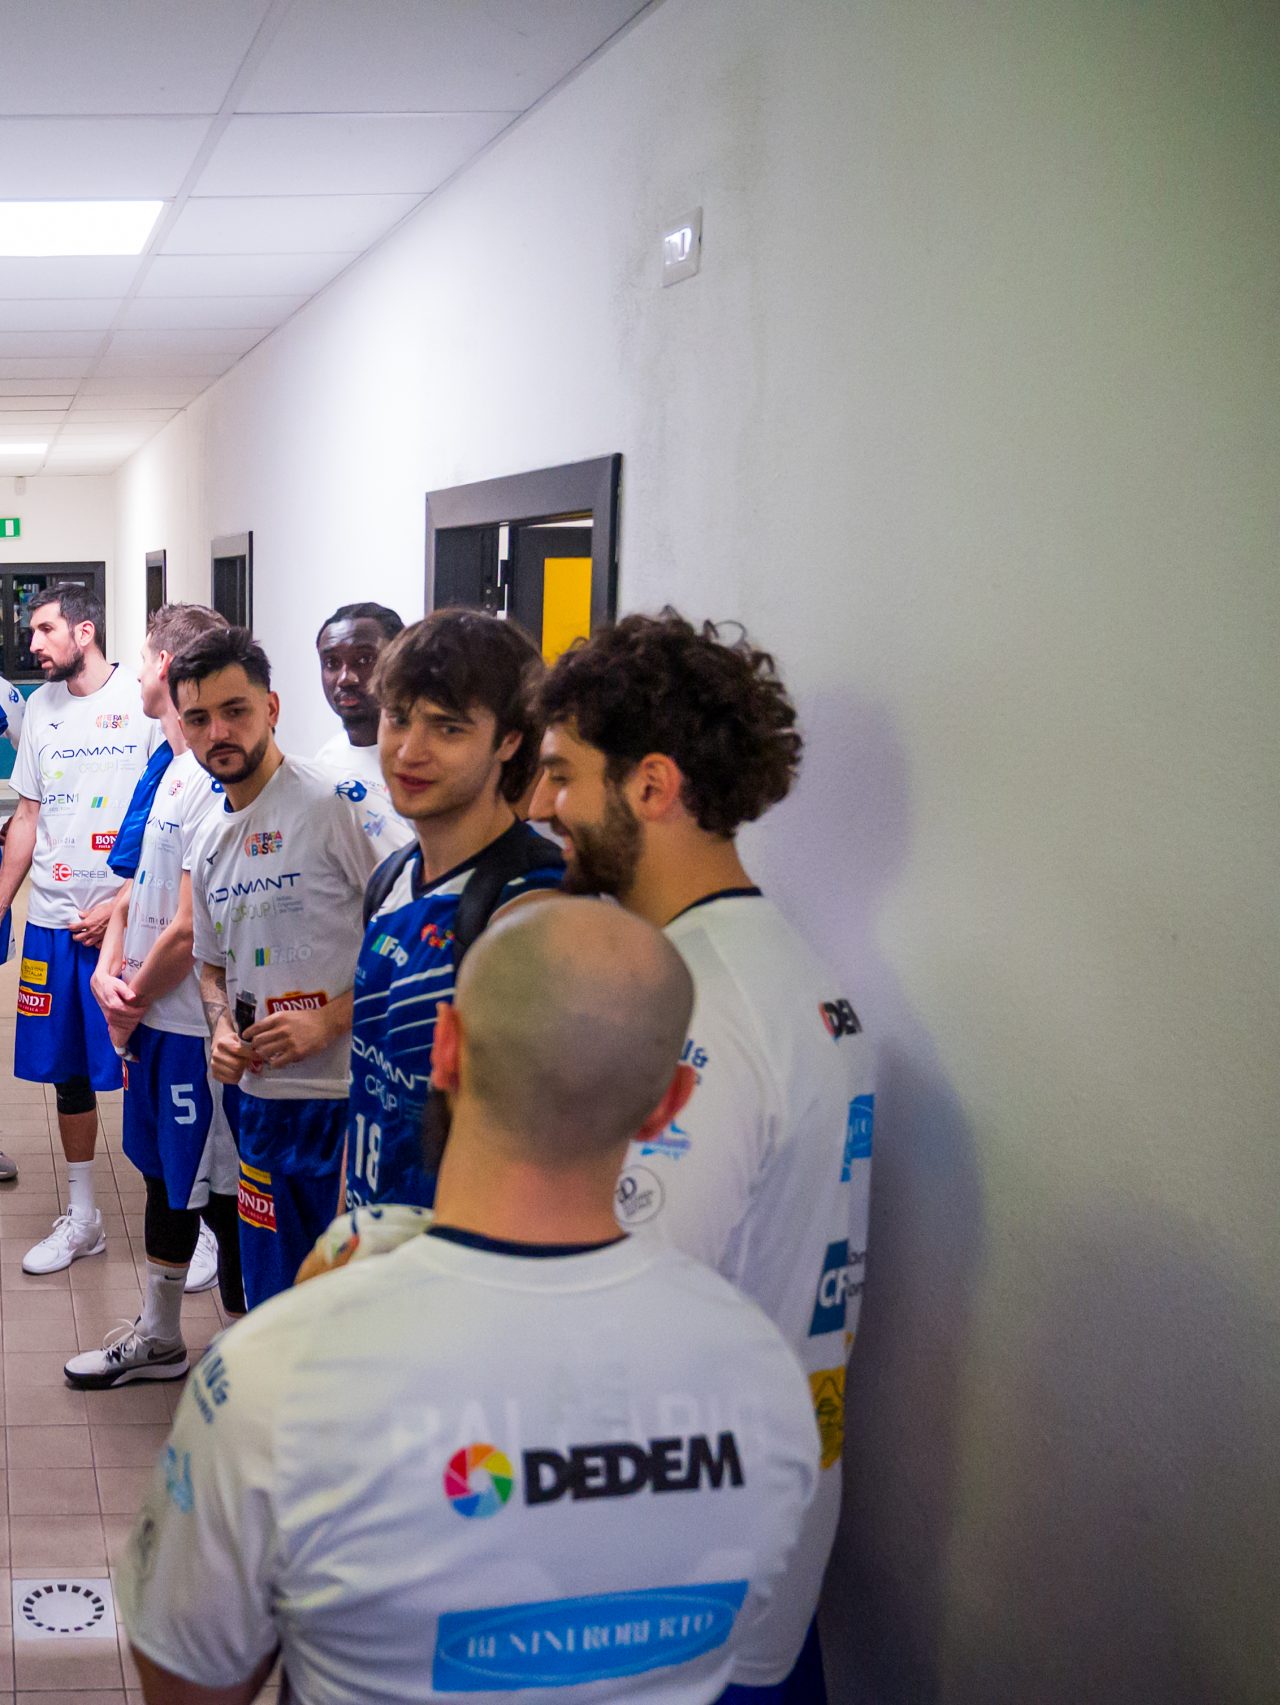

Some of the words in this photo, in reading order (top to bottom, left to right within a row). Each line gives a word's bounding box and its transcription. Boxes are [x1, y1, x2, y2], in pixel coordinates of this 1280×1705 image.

[50, 744, 138, 760] ADAMANT
[95, 834, 118, 845] BON
[207, 872, 302, 906] ADAMANT
[352, 1033, 433, 1092] DAMANT
[170, 1083, 197, 1125] 5
[354, 1112, 382, 1193] 18
[238, 1188, 275, 1217] ONDI
[523, 1430, 746, 1507] DEDEM
